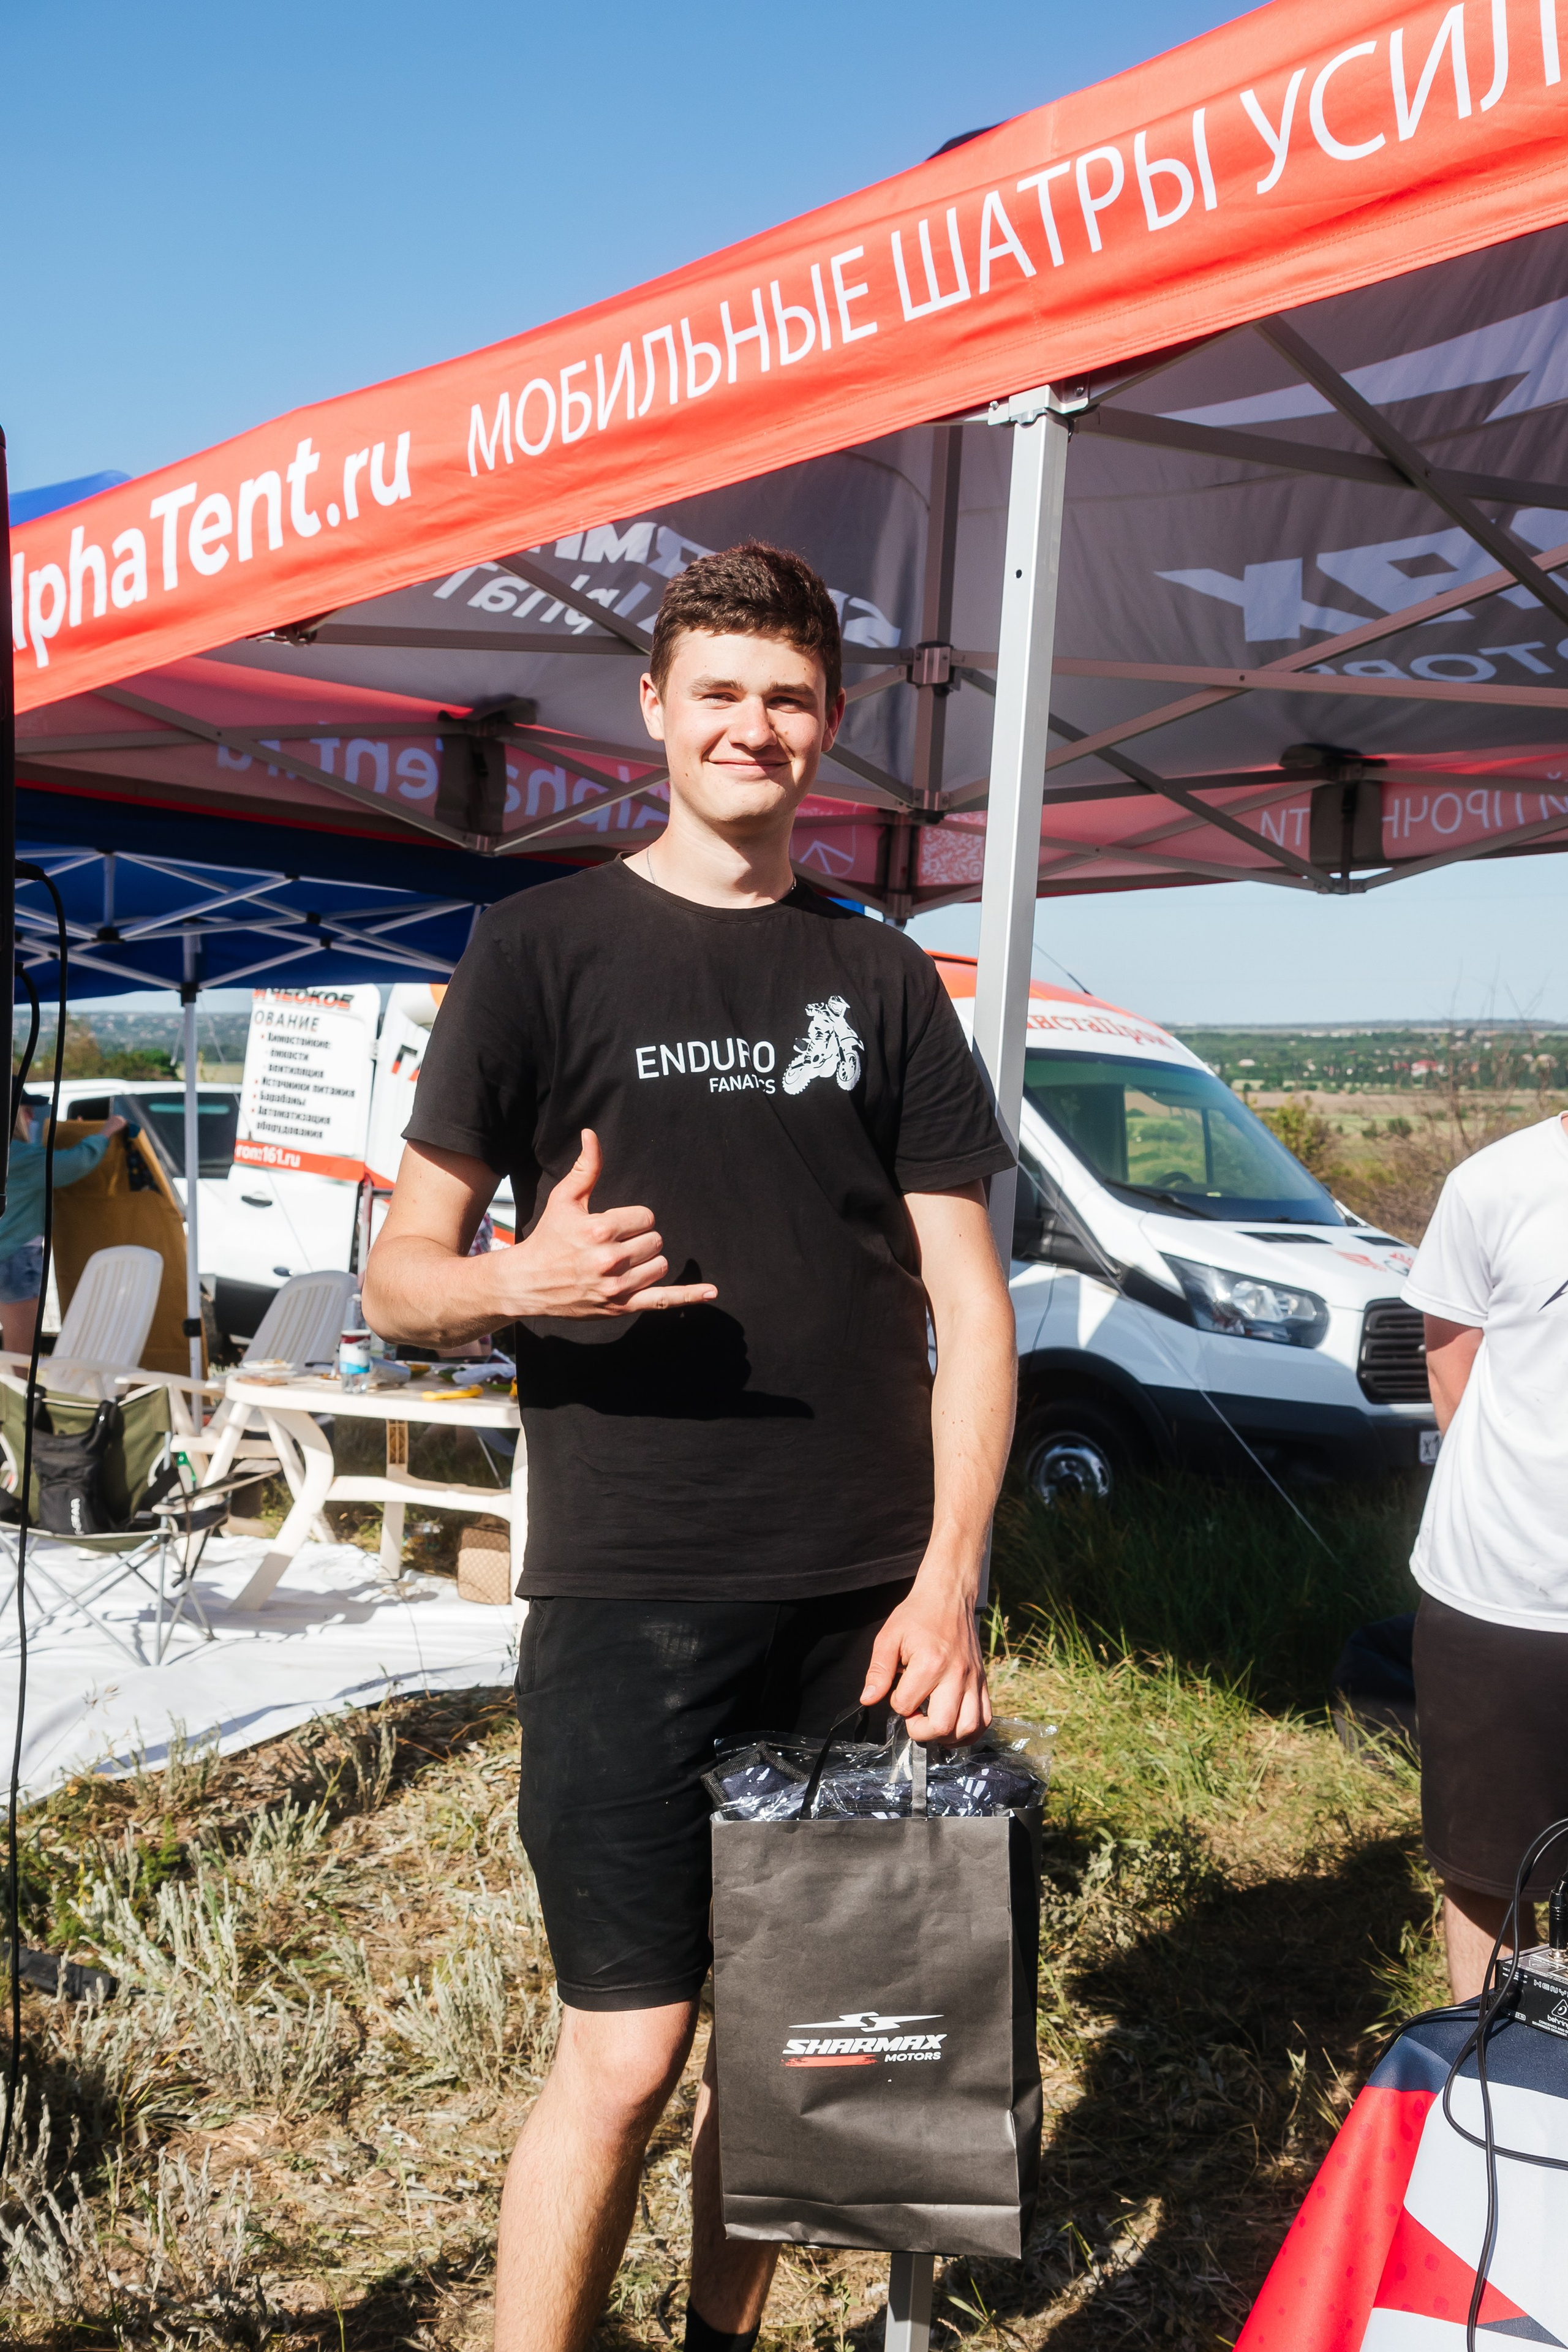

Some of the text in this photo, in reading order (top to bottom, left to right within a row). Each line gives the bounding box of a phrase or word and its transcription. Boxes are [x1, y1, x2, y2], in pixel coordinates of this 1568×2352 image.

[467, 245, 878, 477] МОБИЛЬНЫЕ
[891, 107, 1218, 322] ШАТРЫ
[13, 431, 412, 668] lphaTent.ru
[255, 1010, 320, 1032] ОВАНИЕ
[709, 1074, 776, 1095] FANATCS
[1534, 1979, 1568, 1998] XENY
[782, 2034, 948, 2055] SHARMAX
[884, 2051, 942, 2062] MOTORS
